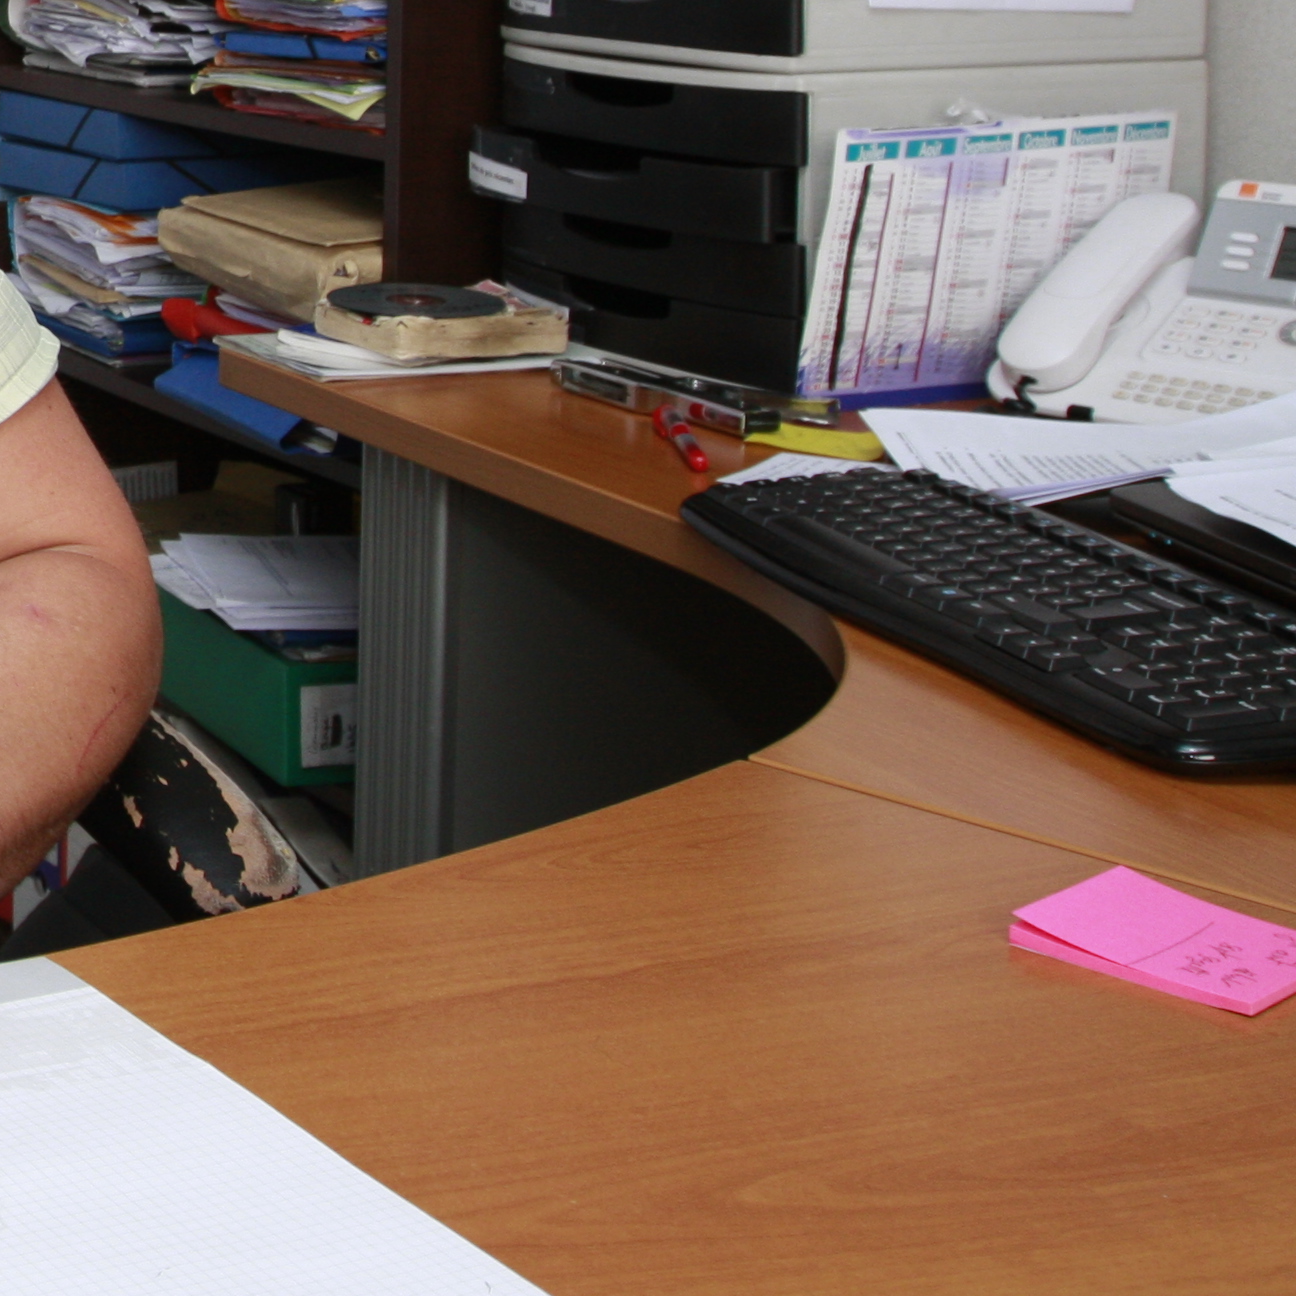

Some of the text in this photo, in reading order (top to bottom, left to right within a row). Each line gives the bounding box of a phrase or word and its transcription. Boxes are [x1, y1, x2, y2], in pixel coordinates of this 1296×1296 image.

[1023, 129, 1060, 149] Octobre
[1071, 125, 1119, 146] Novembre
[1124, 121, 1170, 141] Décembre
[856, 142, 888, 162] Juillet
[918, 139, 944, 158] Août
[962, 133, 1013, 155] Septembre
